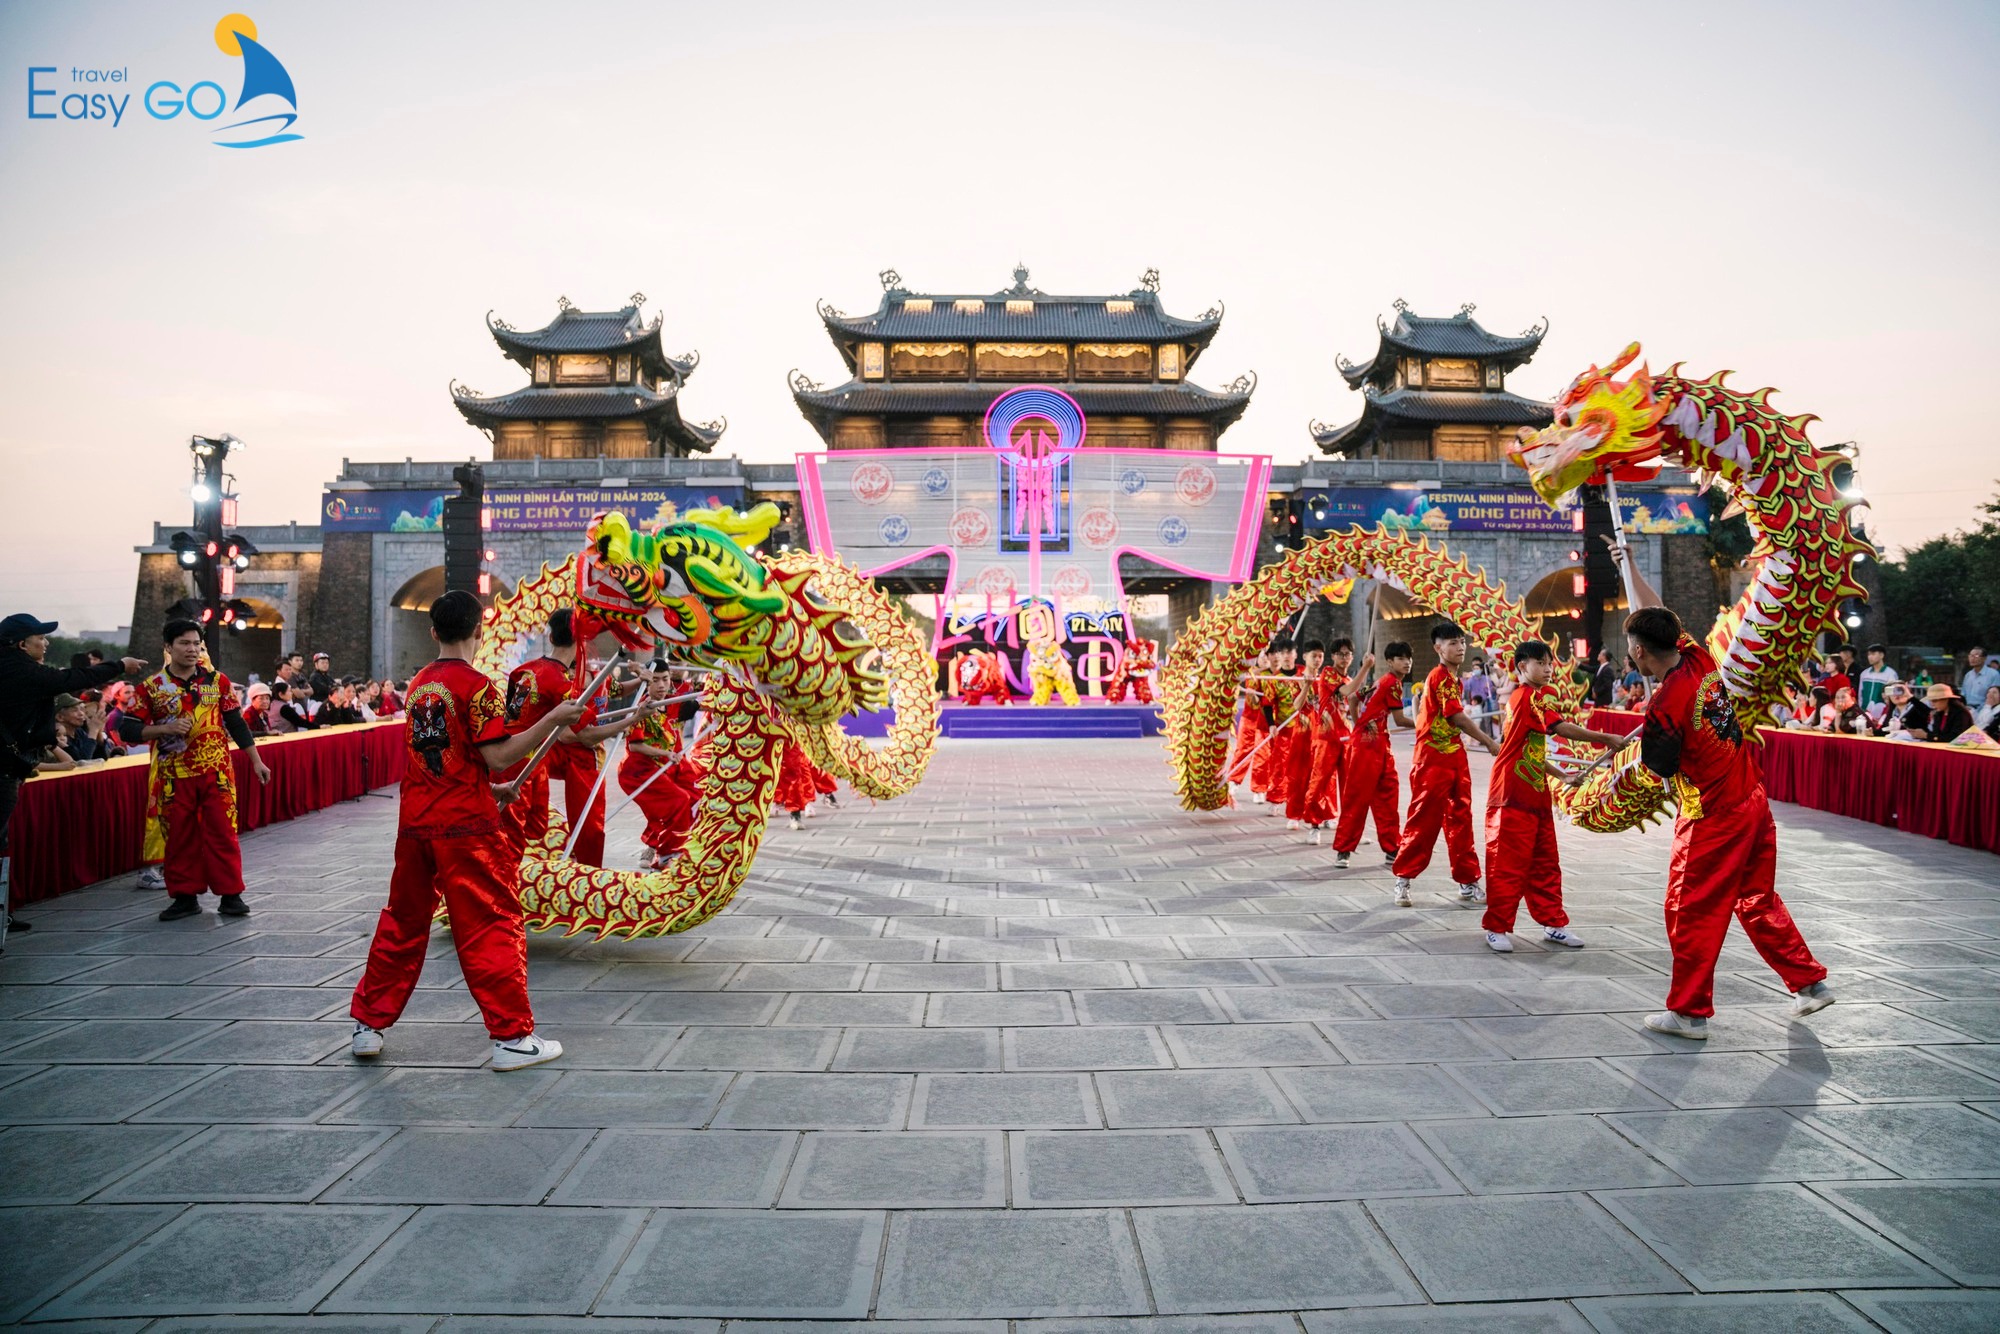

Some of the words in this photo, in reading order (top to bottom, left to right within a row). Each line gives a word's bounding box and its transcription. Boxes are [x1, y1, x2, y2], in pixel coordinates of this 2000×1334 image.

[495, 493, 521, 503] NINH
[523, 491, 550, 503] BÌNH
[600, 492, 611, 503] III
[613, 490, 638, 502] NĂM
[640, 491, 667, 502] 2024
[1429, 493, 1477, 503] FESTIVAL
[1479, 494, 1504, 504] NINH
[1507, 492, 1532, 504] BÌNH
